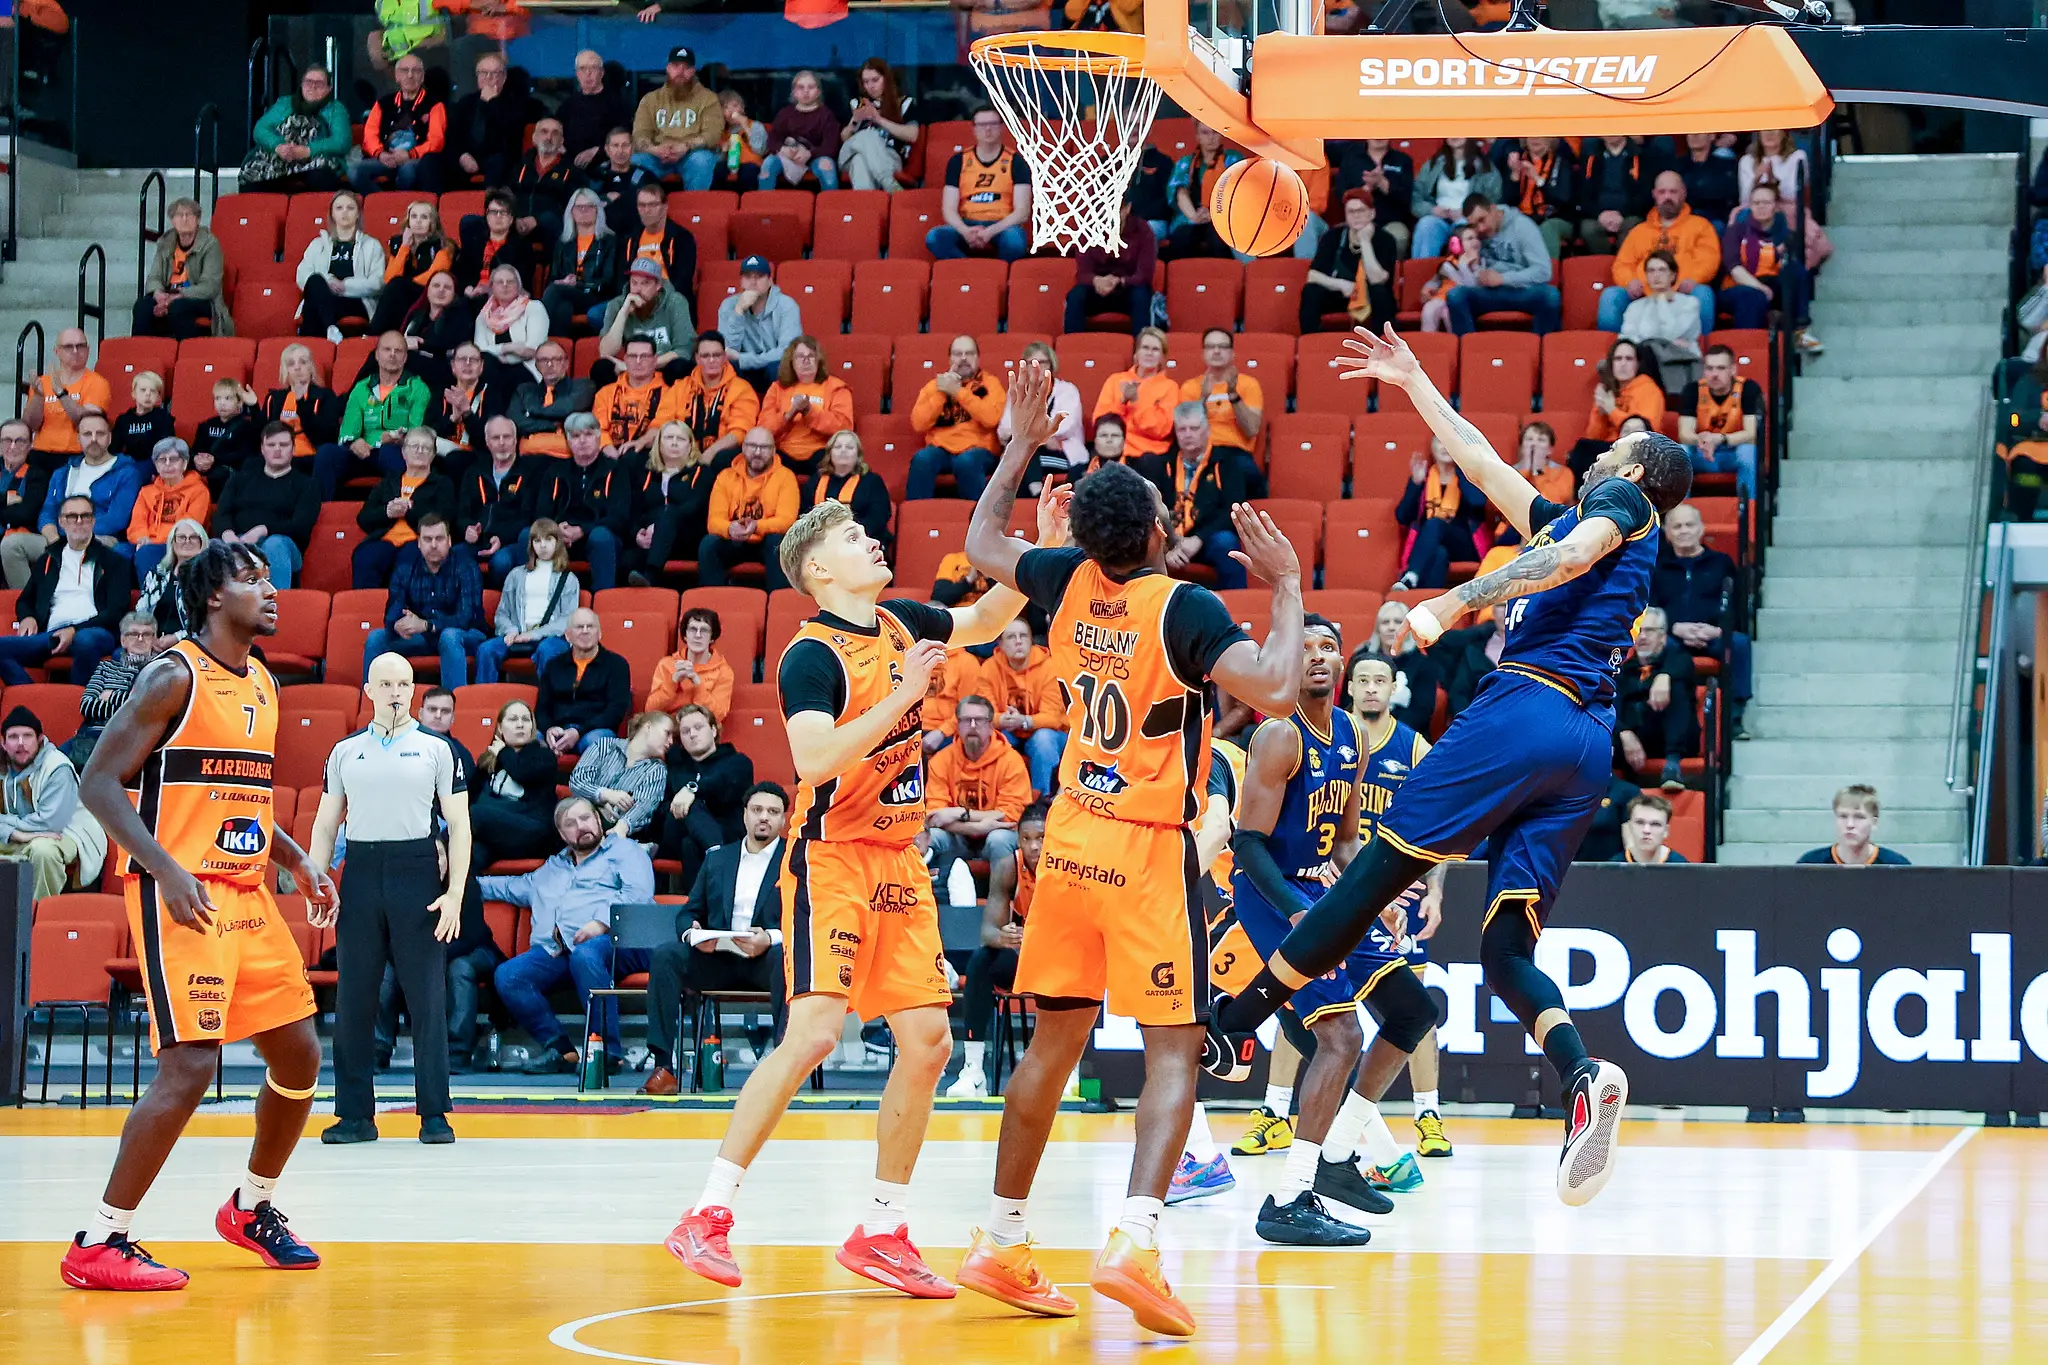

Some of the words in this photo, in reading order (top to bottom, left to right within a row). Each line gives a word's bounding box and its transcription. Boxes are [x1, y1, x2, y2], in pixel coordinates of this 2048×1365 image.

[656, 108, 697, 128] GAP
[1074, 620, 1139, 657] BELLAMY
[241, 704, 256, 738] 7
[1071, 671, 1132, 754] 10
[1316, 823, 1336, 856] 3
[1214, 952, 1236, 976] 3
